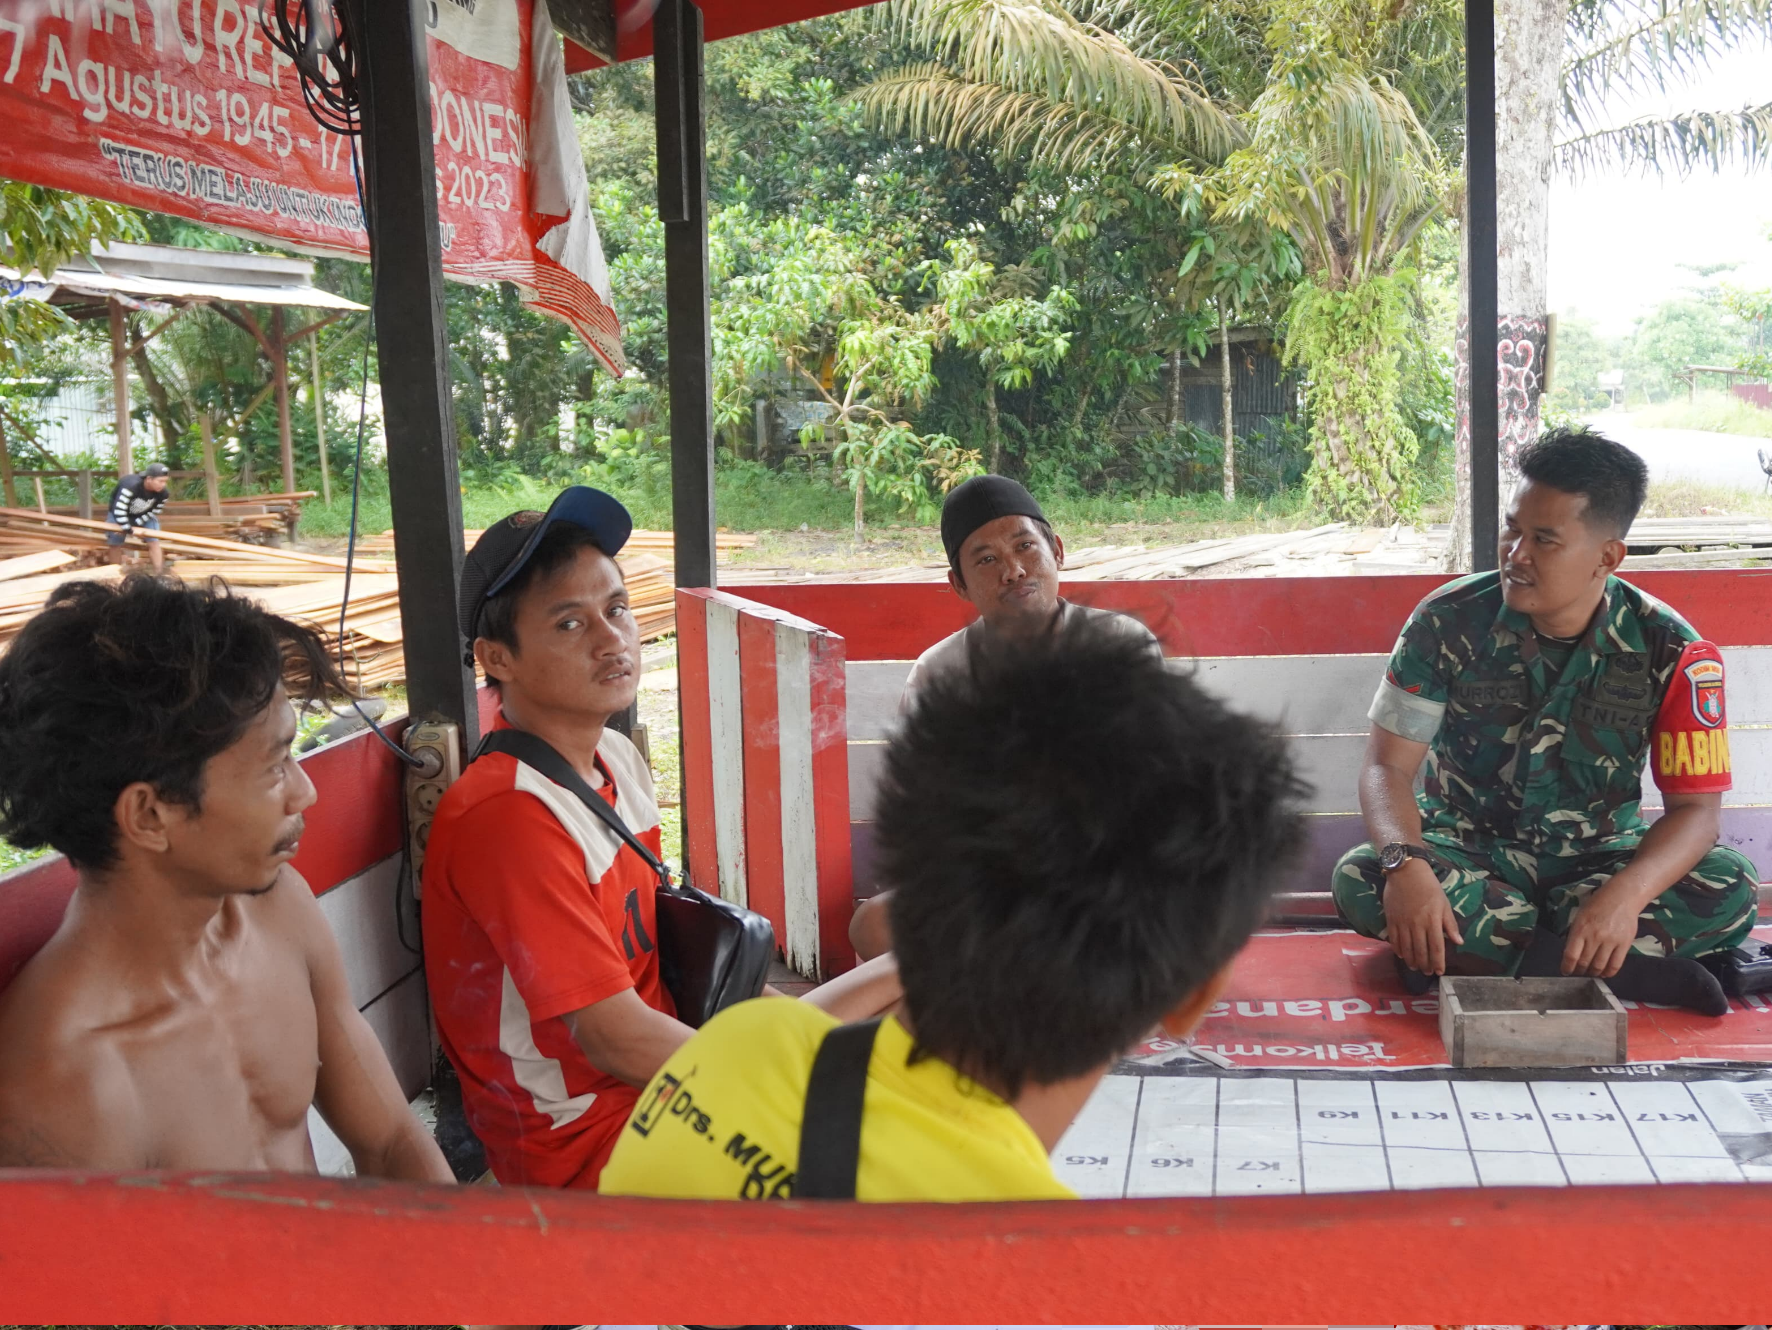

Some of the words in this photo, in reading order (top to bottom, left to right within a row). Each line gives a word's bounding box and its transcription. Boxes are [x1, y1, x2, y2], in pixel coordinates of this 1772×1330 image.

[40, 33, 211, 131] Agustus
[216, 88, 292, 157] 1945
[447, 161, 511, 212] 2023
[1591, 1065, 1666, 1076] Jalan
[671, 1090, 714, 1141] Drs.
[1317, 1111, 1359, 1119] K9
[1391, 1111, 1448, 1120] K11
[1469, 1112, 1533, 1121] K13
[1551, 1113, 1616, 1121] K15
[1636, 1113, 1699, 1122] K17
[1065, 1156, 1108, 1166] K5
[1151, 1157, 1193, 1168] K6
[1236, 1161, 1280, 1171] K7
